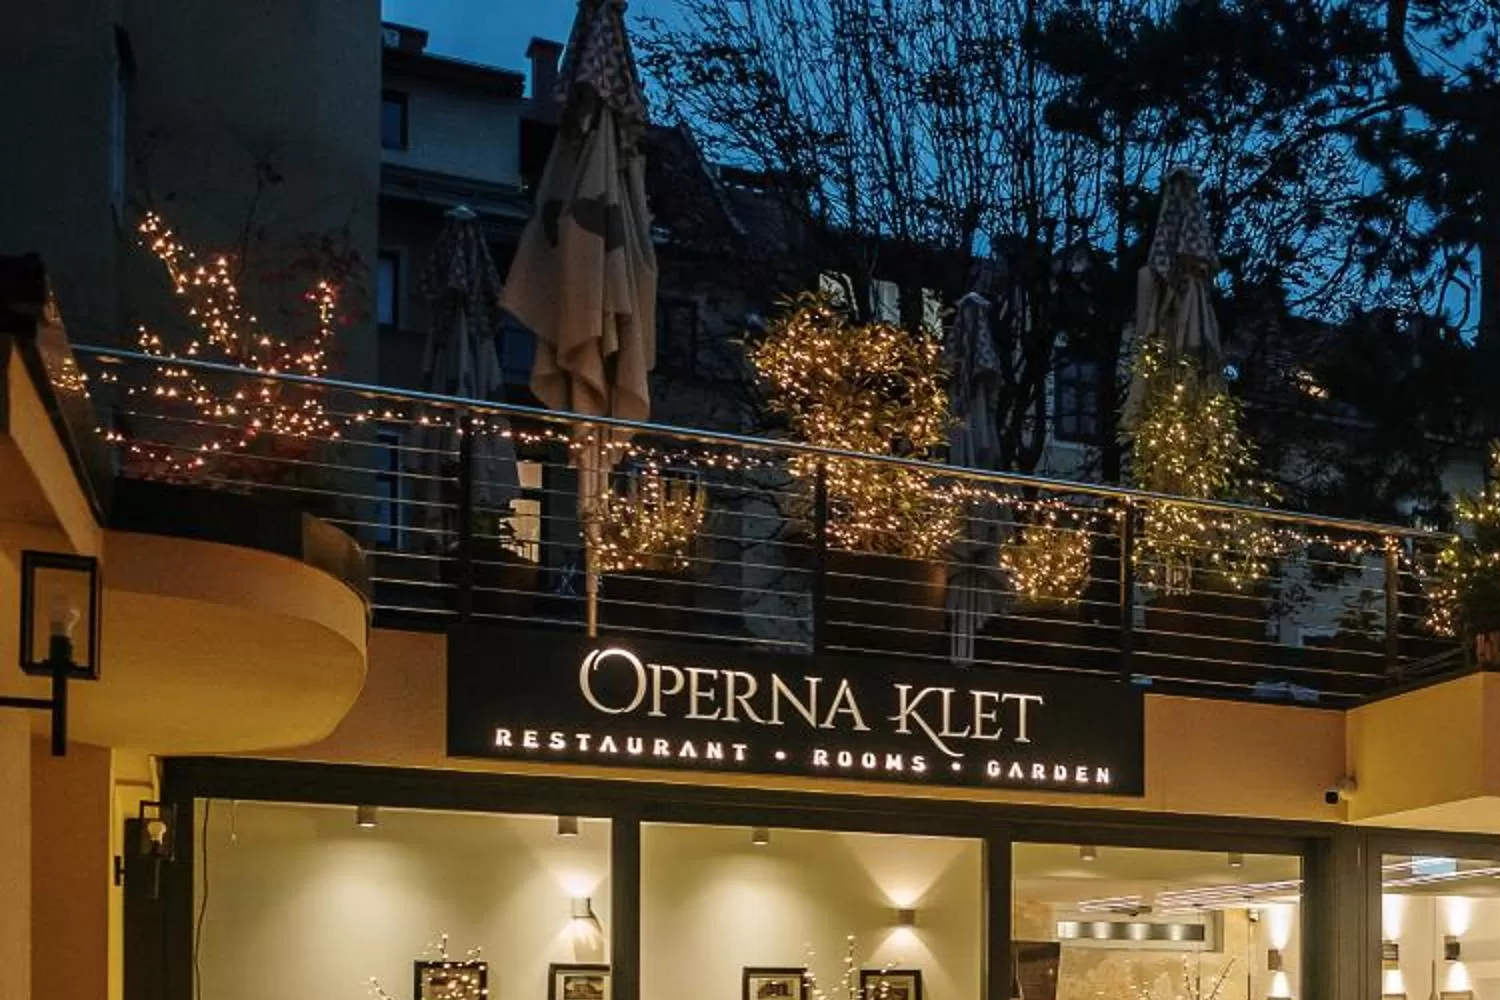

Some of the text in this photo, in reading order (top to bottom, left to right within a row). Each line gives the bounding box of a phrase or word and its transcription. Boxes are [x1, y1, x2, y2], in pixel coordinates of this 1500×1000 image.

[579, 646, 1044, 758] OPERNA KLET
[495, 727, 1112, 785] RESTAURANT ROOMS GARDEN
